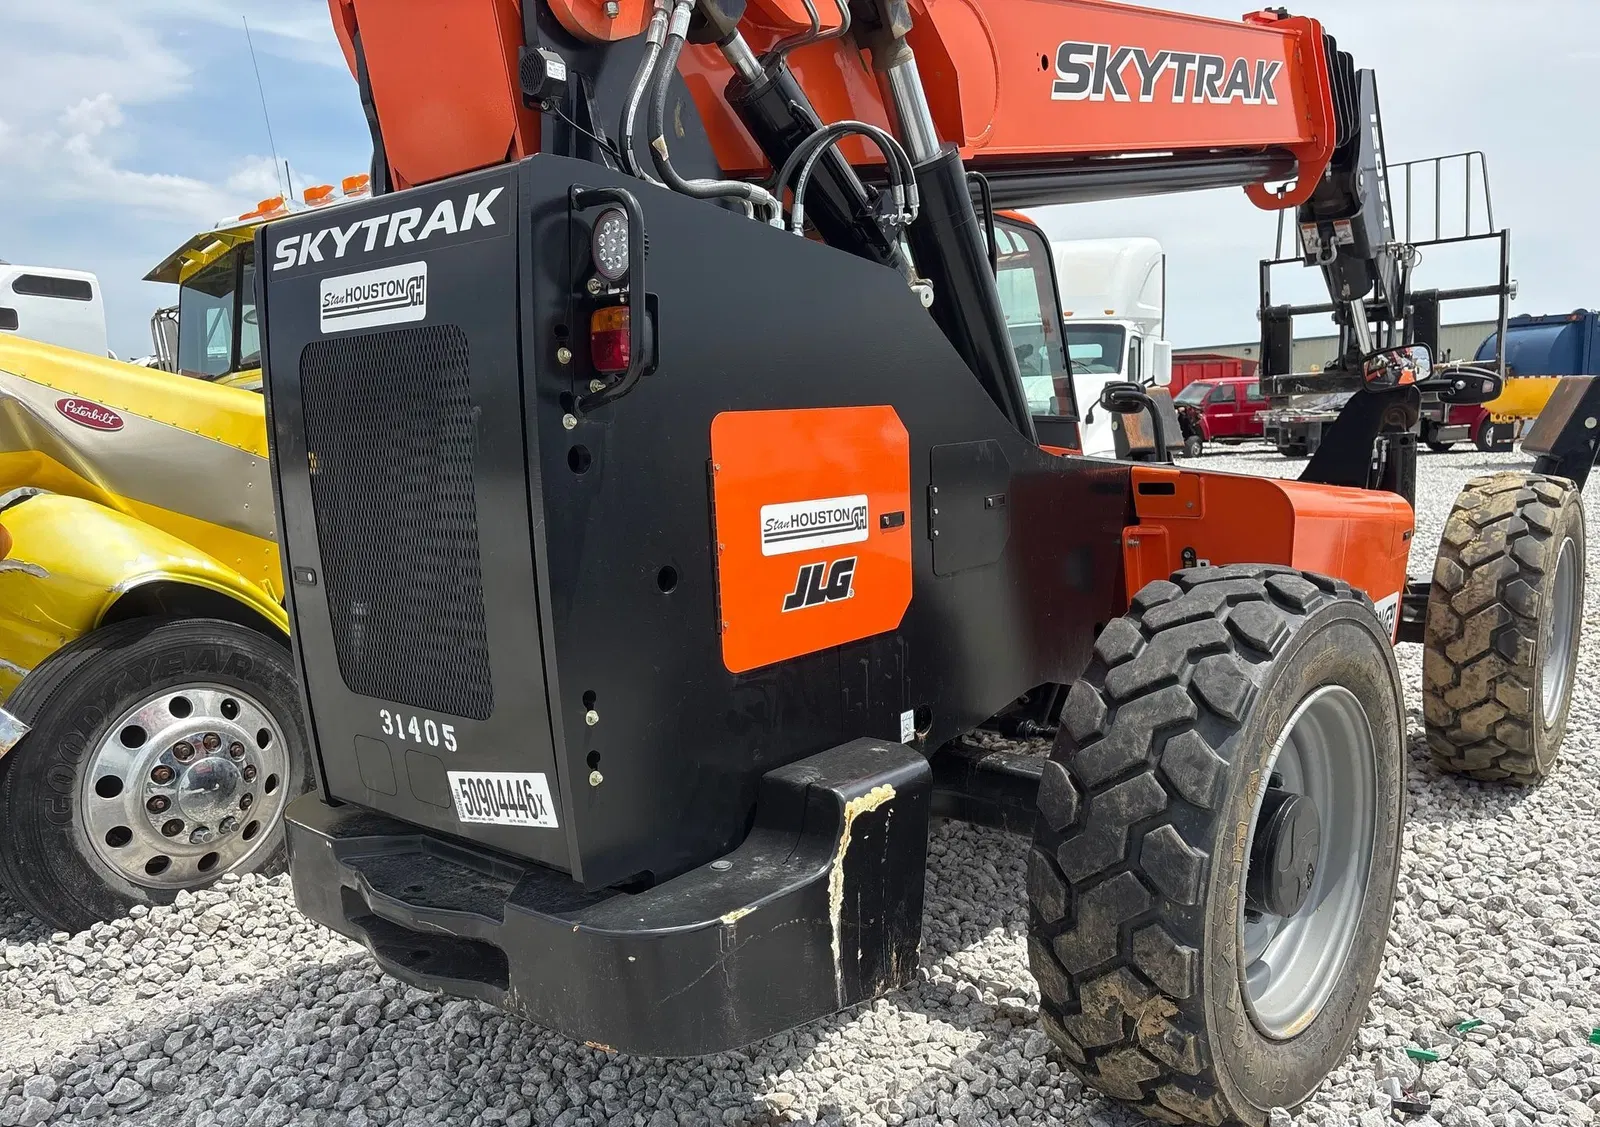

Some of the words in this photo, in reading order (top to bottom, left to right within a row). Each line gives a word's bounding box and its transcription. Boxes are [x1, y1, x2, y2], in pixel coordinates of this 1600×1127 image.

[1051, 41, 1283, 105] SKYTRAK
[273, 187, 504, 271] SKYTRAK
[322, 291, 345, 308] Stan
[345, 279, 405, 303] HOUSTON
[64, 400, 119, 425] Peterbilt
[764, 518, 790, 532] Stan
[790, 508, 850, 528] HOUSTON
[782, 556, 857, 613] JLG
[379, 709, 458, 752] 31405
